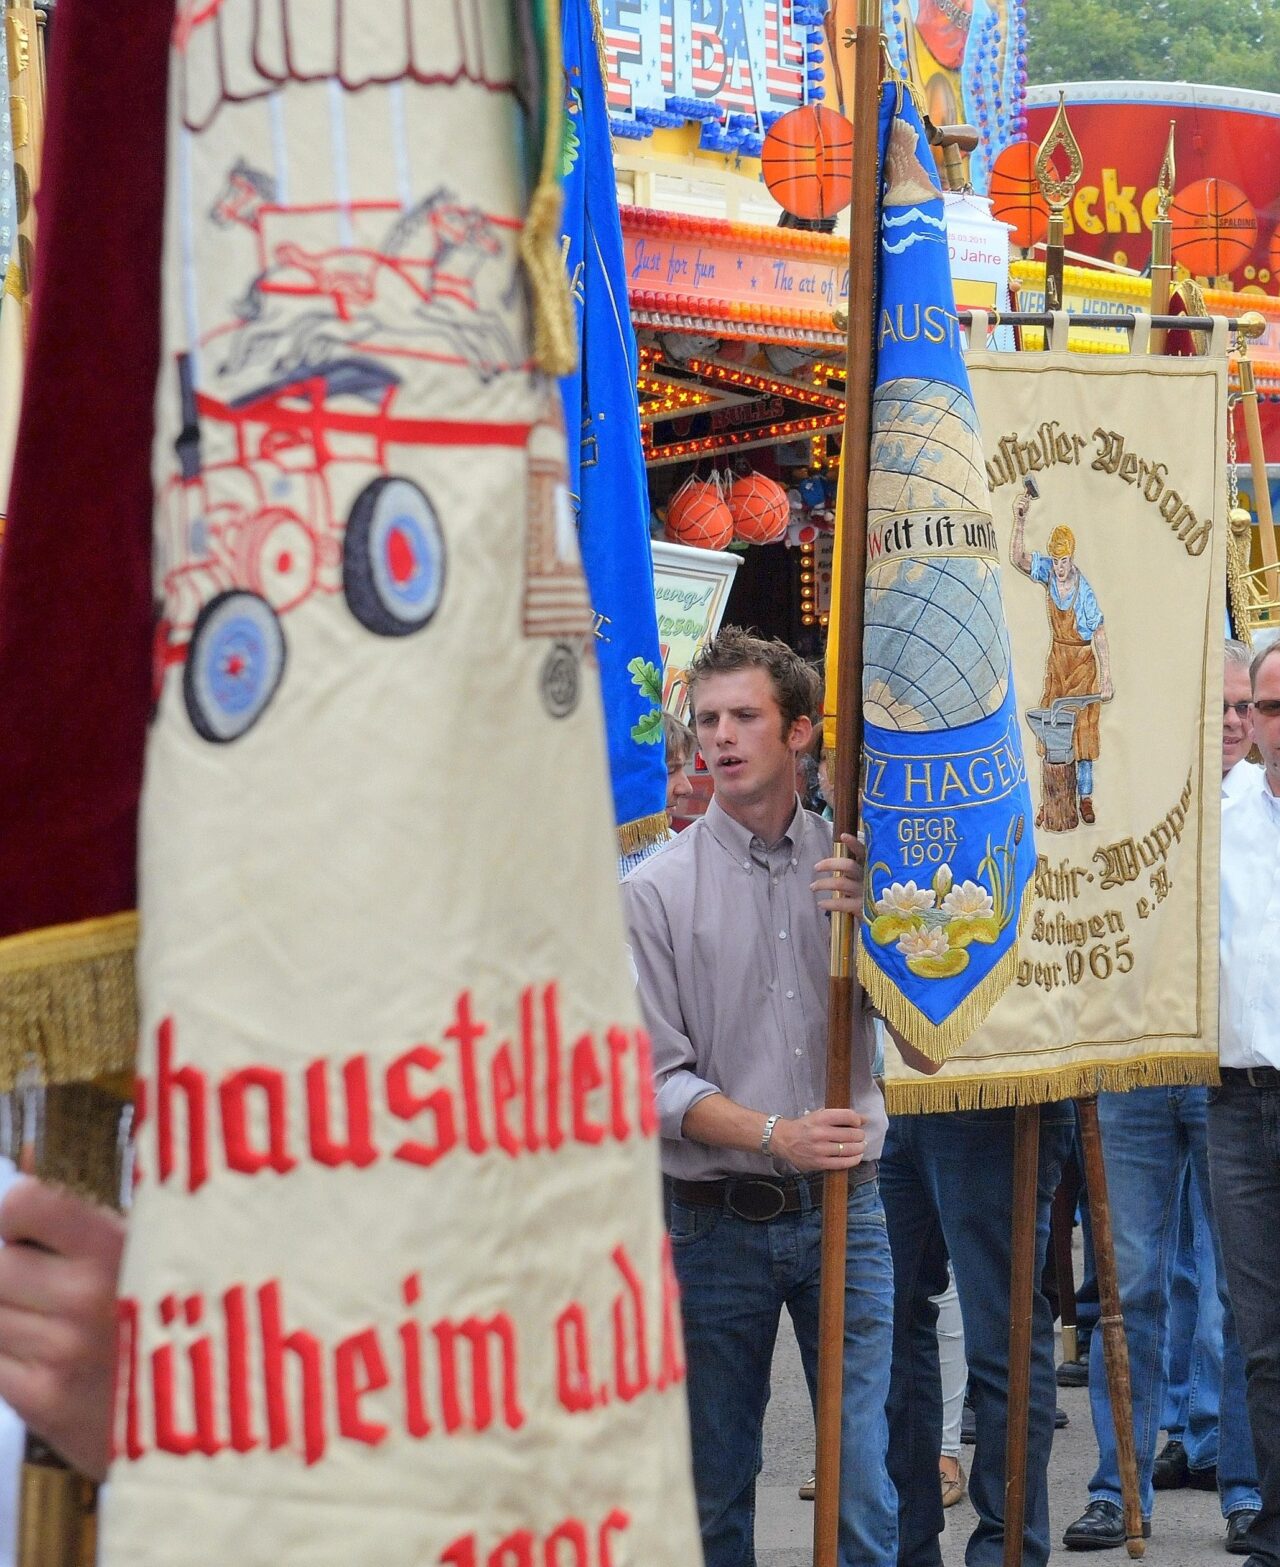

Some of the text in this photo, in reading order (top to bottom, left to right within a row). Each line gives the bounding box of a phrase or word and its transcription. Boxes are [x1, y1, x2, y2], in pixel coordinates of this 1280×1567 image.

[1218, 217, 1257, 228] SPALDING
[632, 239, 661, 280] Just
[667, 245, 688, 285] for
[693, 249, 716, 288] fun
[961, 248, 1002, 265] Jahre
[773, 260, 793, 291] The
[799, 275, 816, 294] art
[821, 268, 834, 306] of
[1091, 427, 1213, 557] Verband
[868, 517, 914, 562] Welt
[904, 740, 1022, 803] HAGEN
[898, 817, 964, 843] GEGR.
[899, 842, 958, 867] 1907
[1016, 959, 1067, 993] gegr.
